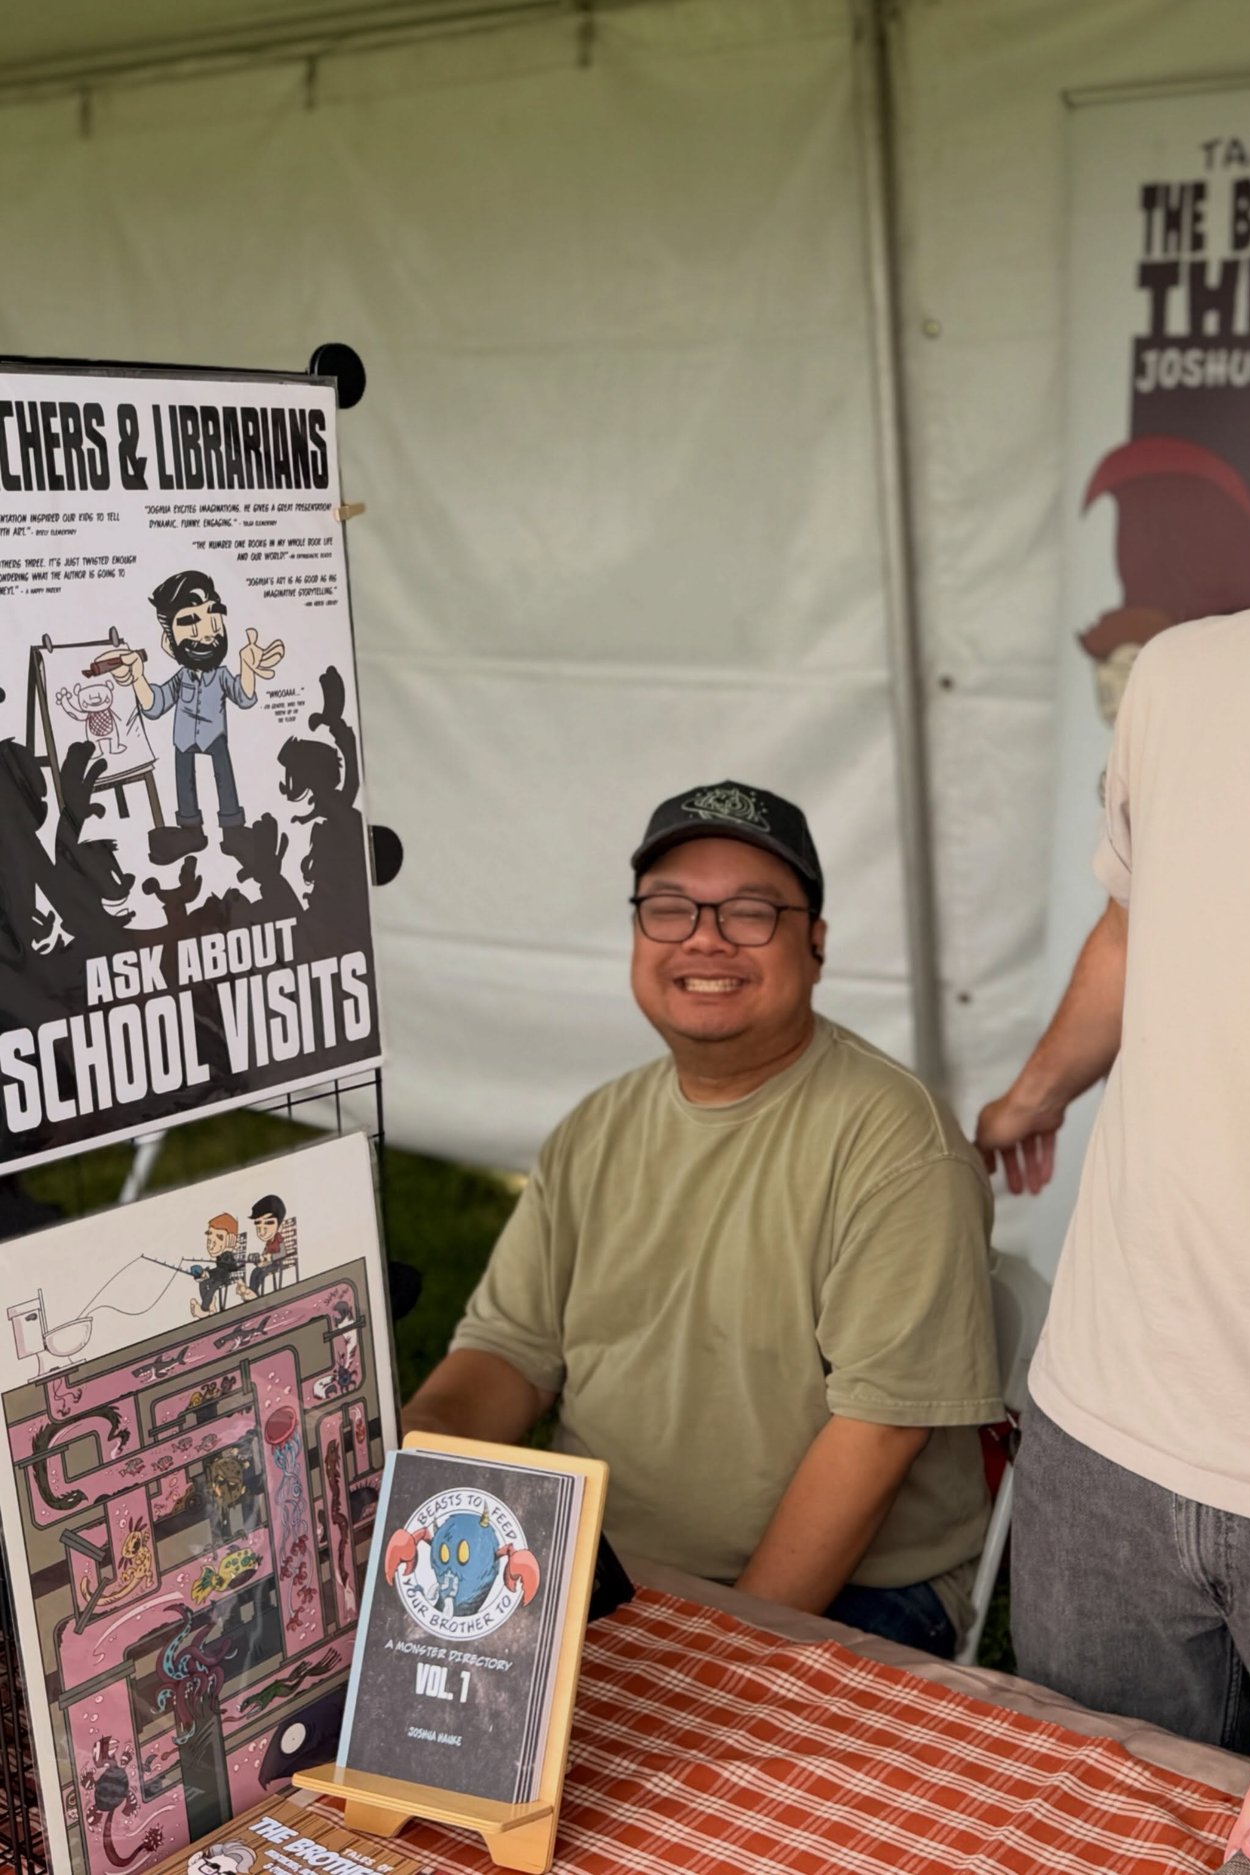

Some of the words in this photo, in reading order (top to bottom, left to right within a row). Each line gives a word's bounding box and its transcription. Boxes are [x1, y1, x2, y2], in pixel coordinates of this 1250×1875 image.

[1140, 179, 1208, 256] THE
[117, 402, 149, 491] &
[151, 404, 329, 491] LIBRARIANS
[30, 512, 60, 523] INSPIRED
[62, 512, 76, 523] OUR
[78, 512, 94, 522] KIDS
[96, 512, 105, 522] TO
[107, 511, 120, 522] TELL
[234, 539, 245, 549] ONE
[248, 539, 267, 548] BOOKS
[287, 537, 305, 547] WHOLE
[250, 552, 262, 561] OUR
[0, 559, 21, 569] THERS
[64, 557, 80, 567] JUST
[82, 556, 110, 567] TWISTED
[112, 555, 137, 565] ENOUGH
[31, 571, 49, 581] WHAT
[51, 571, 62, 581] THE
[63, 570, 87, 580] AUTHOR
[89, 569, 95, 579] IS
[97, 569, 116, 579] GOING
[118, 568, 125, 578] TO
[86, 944, 168, 1006] ASK
[178, 917, 298, 986] ABOUT
[0, 991, 210, 1134] SCHOOL
[217, 951, 372, 1075] VISITS
[417, 1494, 463, 1526] BEASTS
[468, 1495, 483, 1508] TO
[491, 1507, 518, 1540] FEED
[402, 1578, 429, 1618] YOUR
[429, 1612, 495, 1633] BROTHER
[495, 1595, 512, 1614] TO
[384, 1639, 394, 1649] A
[395, 1640, 447, 1659] MONSTER
[448, 1650, 513, 1672] DIRECTORY
[415, 1662, 454, 1700] VOL.
[459, 1670, 471, 1703] 1
[407, 1726, 437, 1741] JOSHUA
[249, 1816, 299, 1844] THE
[342, 1848, 376, 1866] TALES
[377, 1863, 394, 1873] OF
